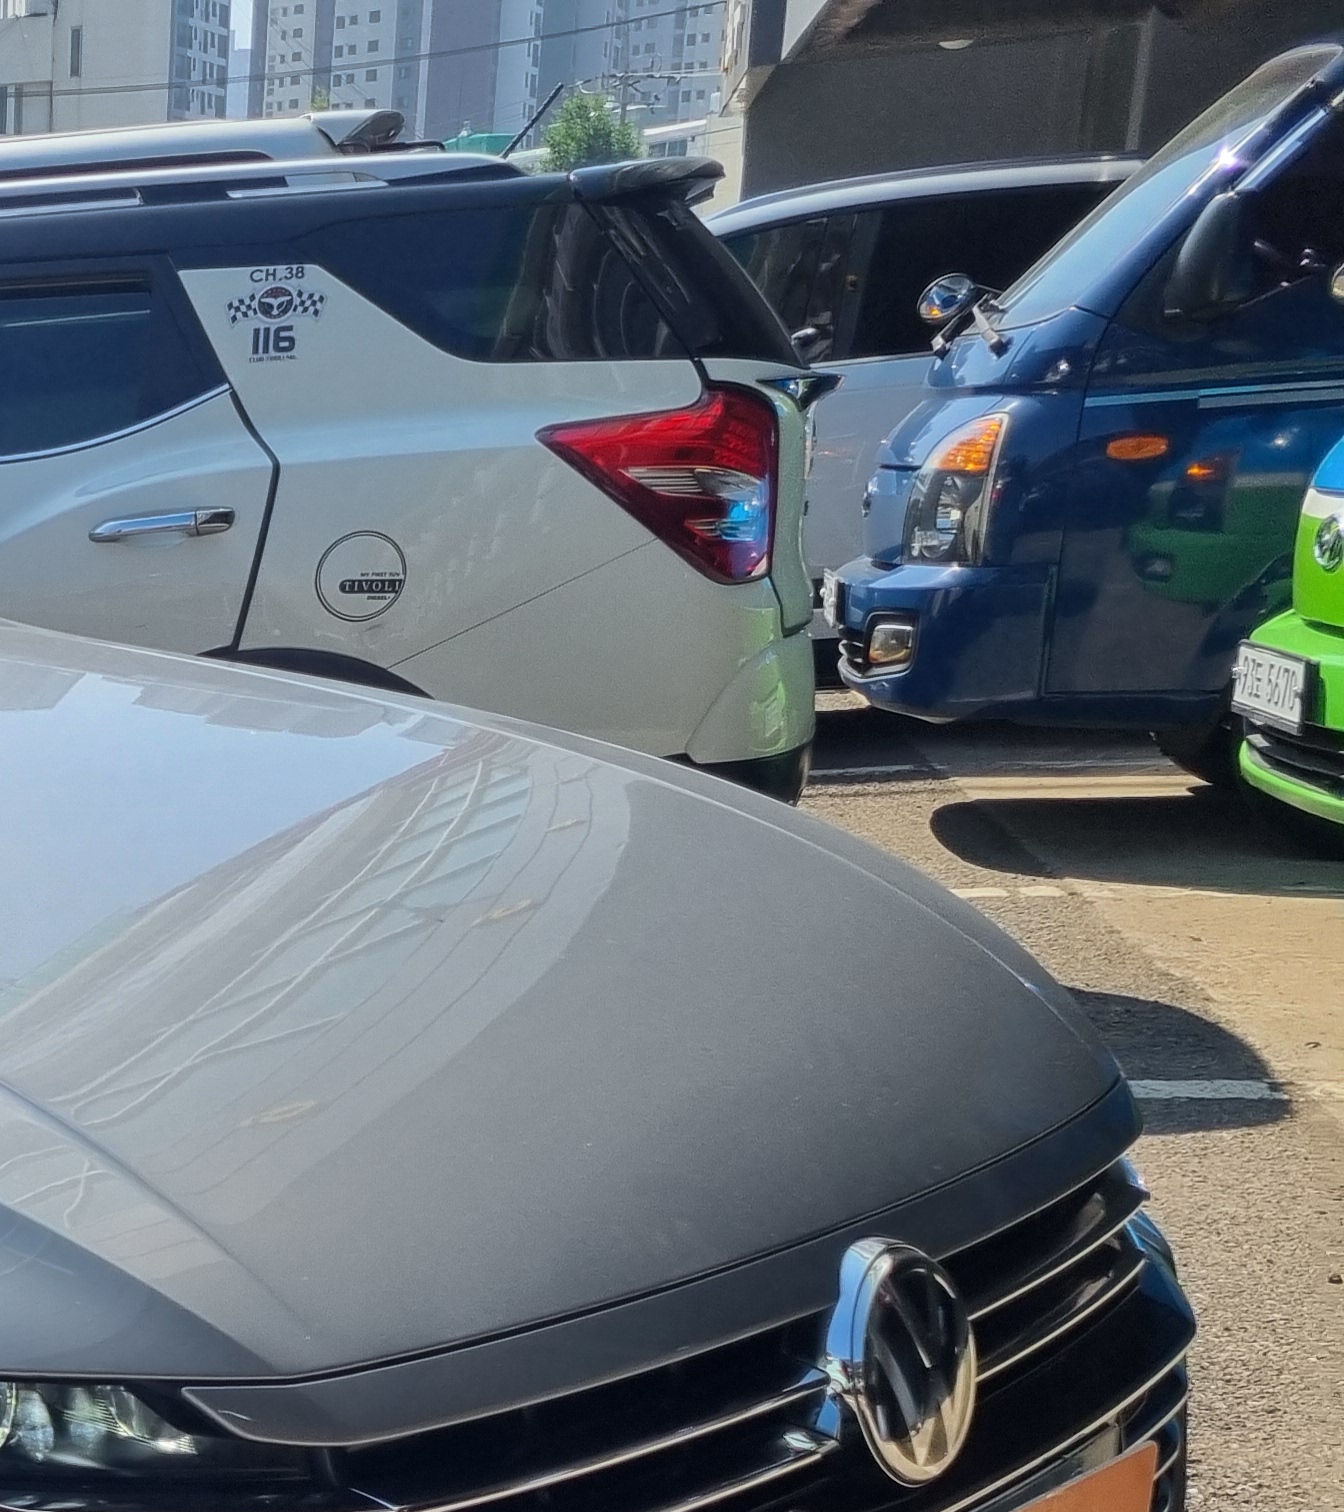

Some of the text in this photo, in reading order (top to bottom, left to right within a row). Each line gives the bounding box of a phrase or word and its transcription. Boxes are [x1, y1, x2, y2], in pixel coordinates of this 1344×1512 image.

[249, 265, 305, 283] CH.38
[252, 325, 296, 354] 116
[343, 581, 400, 592] TIVOLI
